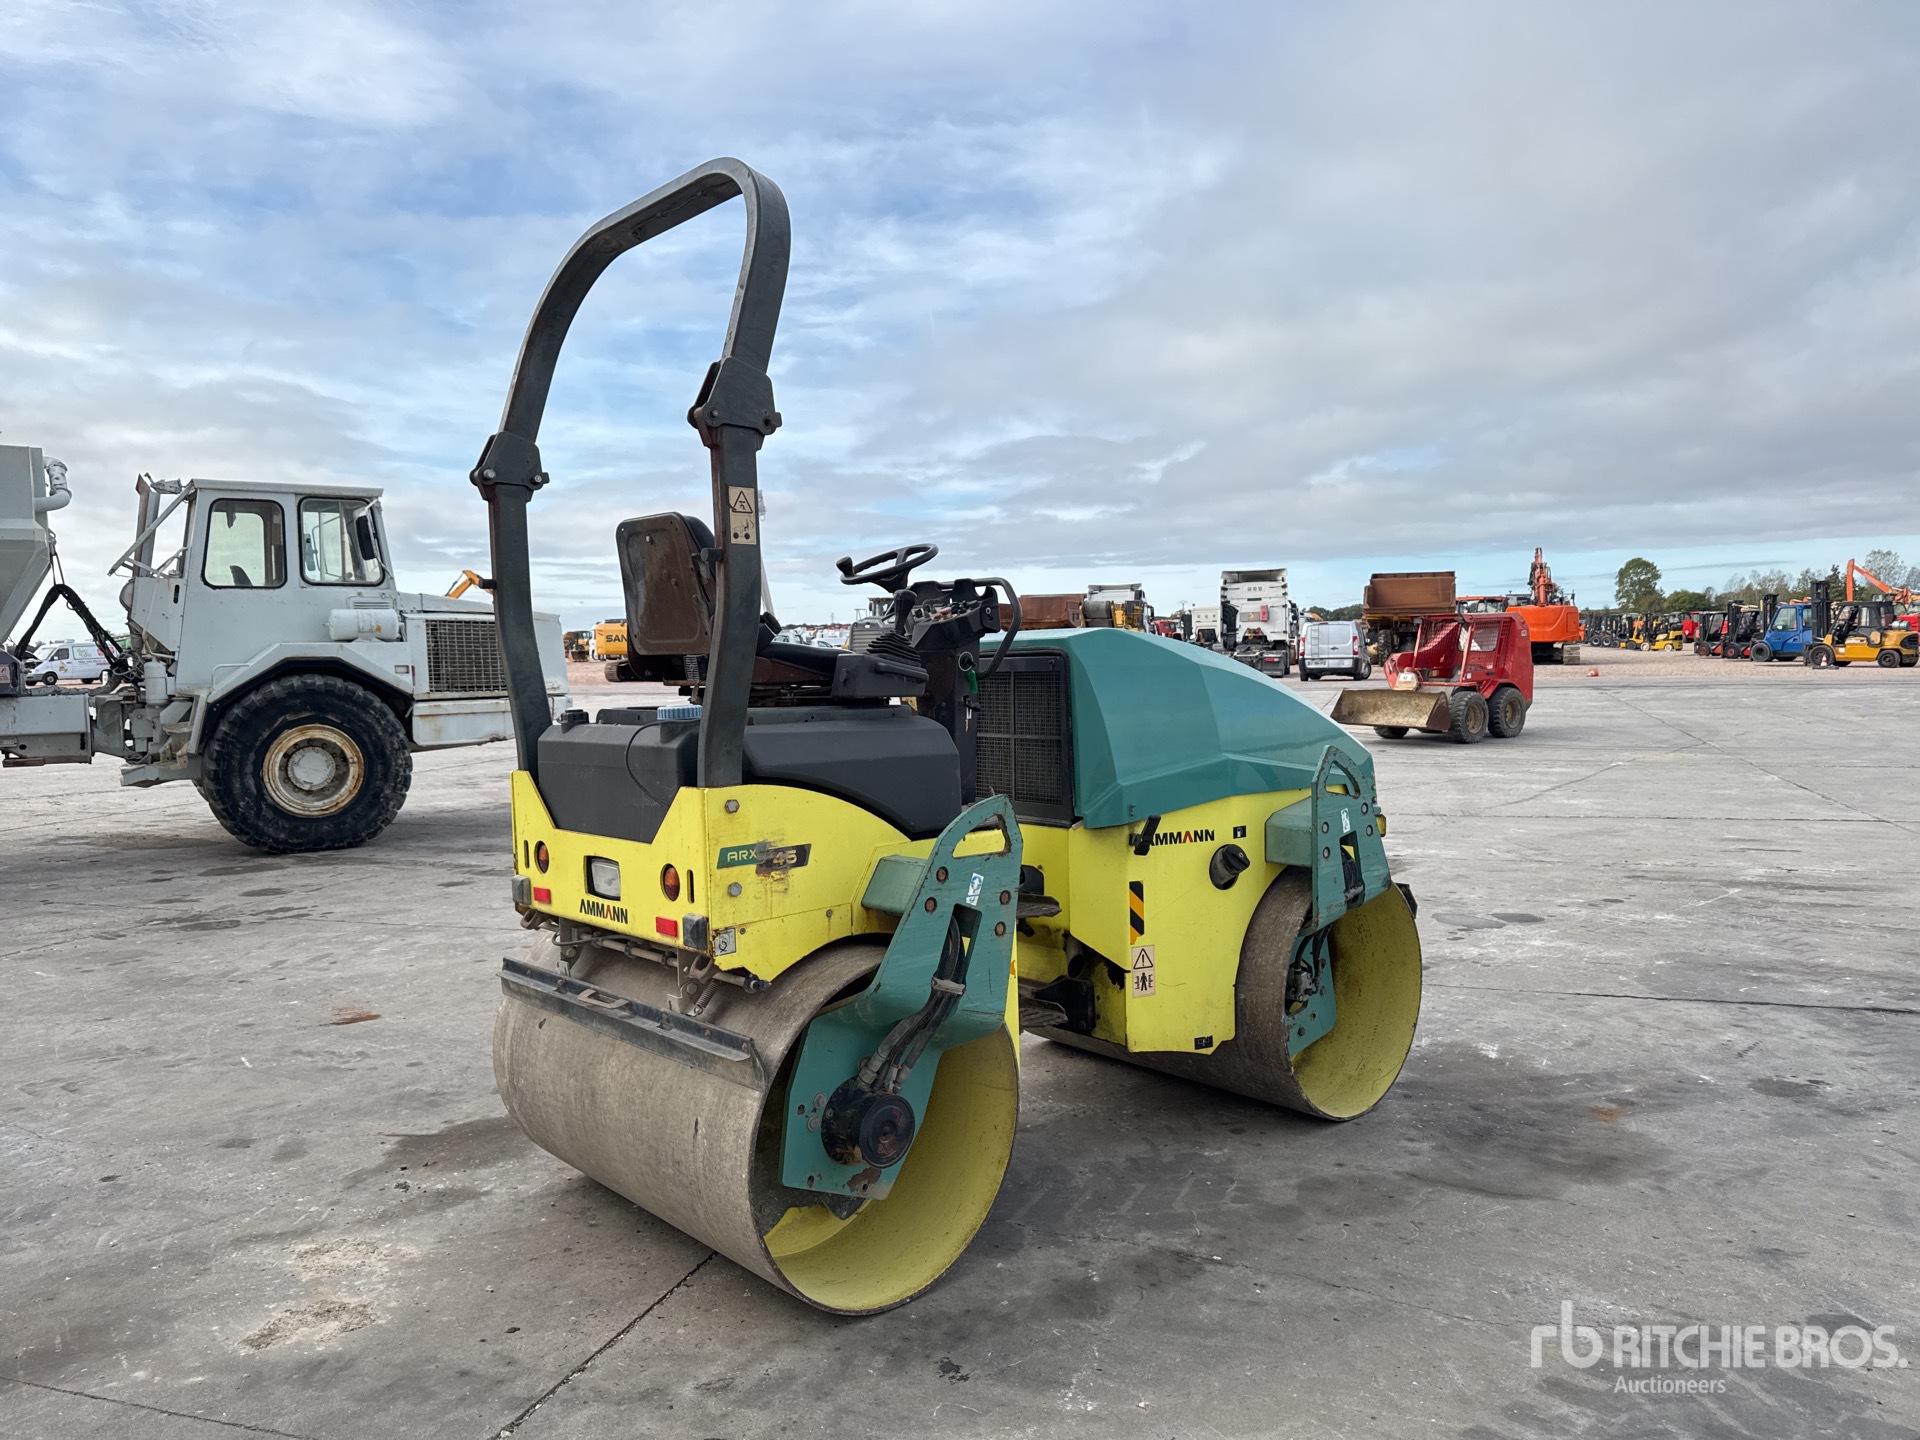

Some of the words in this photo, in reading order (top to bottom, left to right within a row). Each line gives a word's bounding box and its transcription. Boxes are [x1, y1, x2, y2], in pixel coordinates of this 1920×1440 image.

[727, 849, 757, 862] ARX
[772, 849, 797, 866] 45
[579, 898, 628, 925] AMMANN
